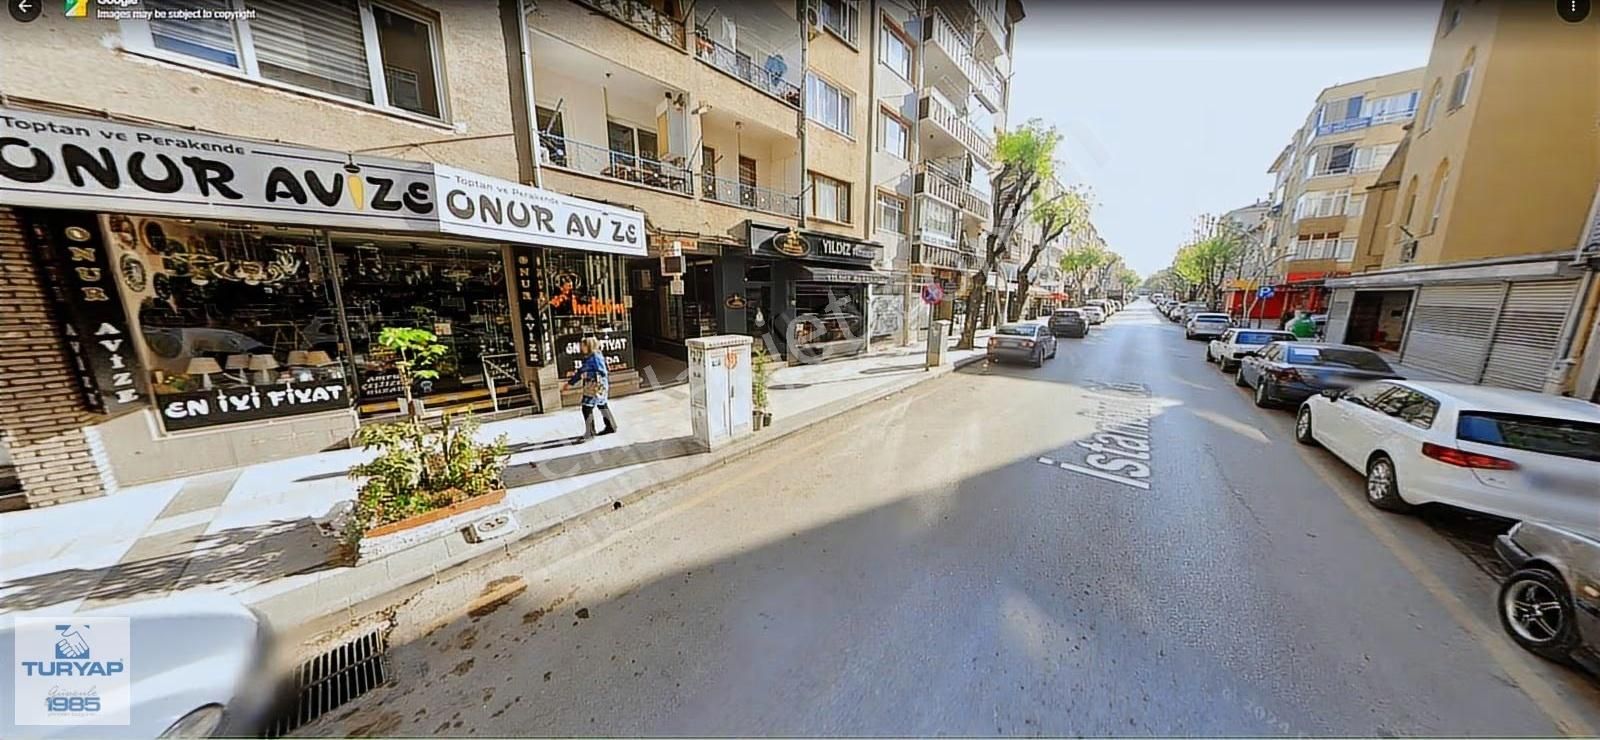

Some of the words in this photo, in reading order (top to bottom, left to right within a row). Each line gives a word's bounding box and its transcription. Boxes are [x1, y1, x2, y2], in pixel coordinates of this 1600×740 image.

[1, 116, 90, 135] Toptan
[101, 129, 127, 141] ve
[137, 132, 244, 155] Perakende
[0, 136, 244, 200] ONUR
[455, 174, 493, 191] Toptan
[446, 189, 555, 234] ONUR
[65, 226, 109, 301] ONUR
[822, 238, 852, 257] YILDIZ
[518, 256, 533, 301] ONUR
[164, 399, 209, 418] EN
